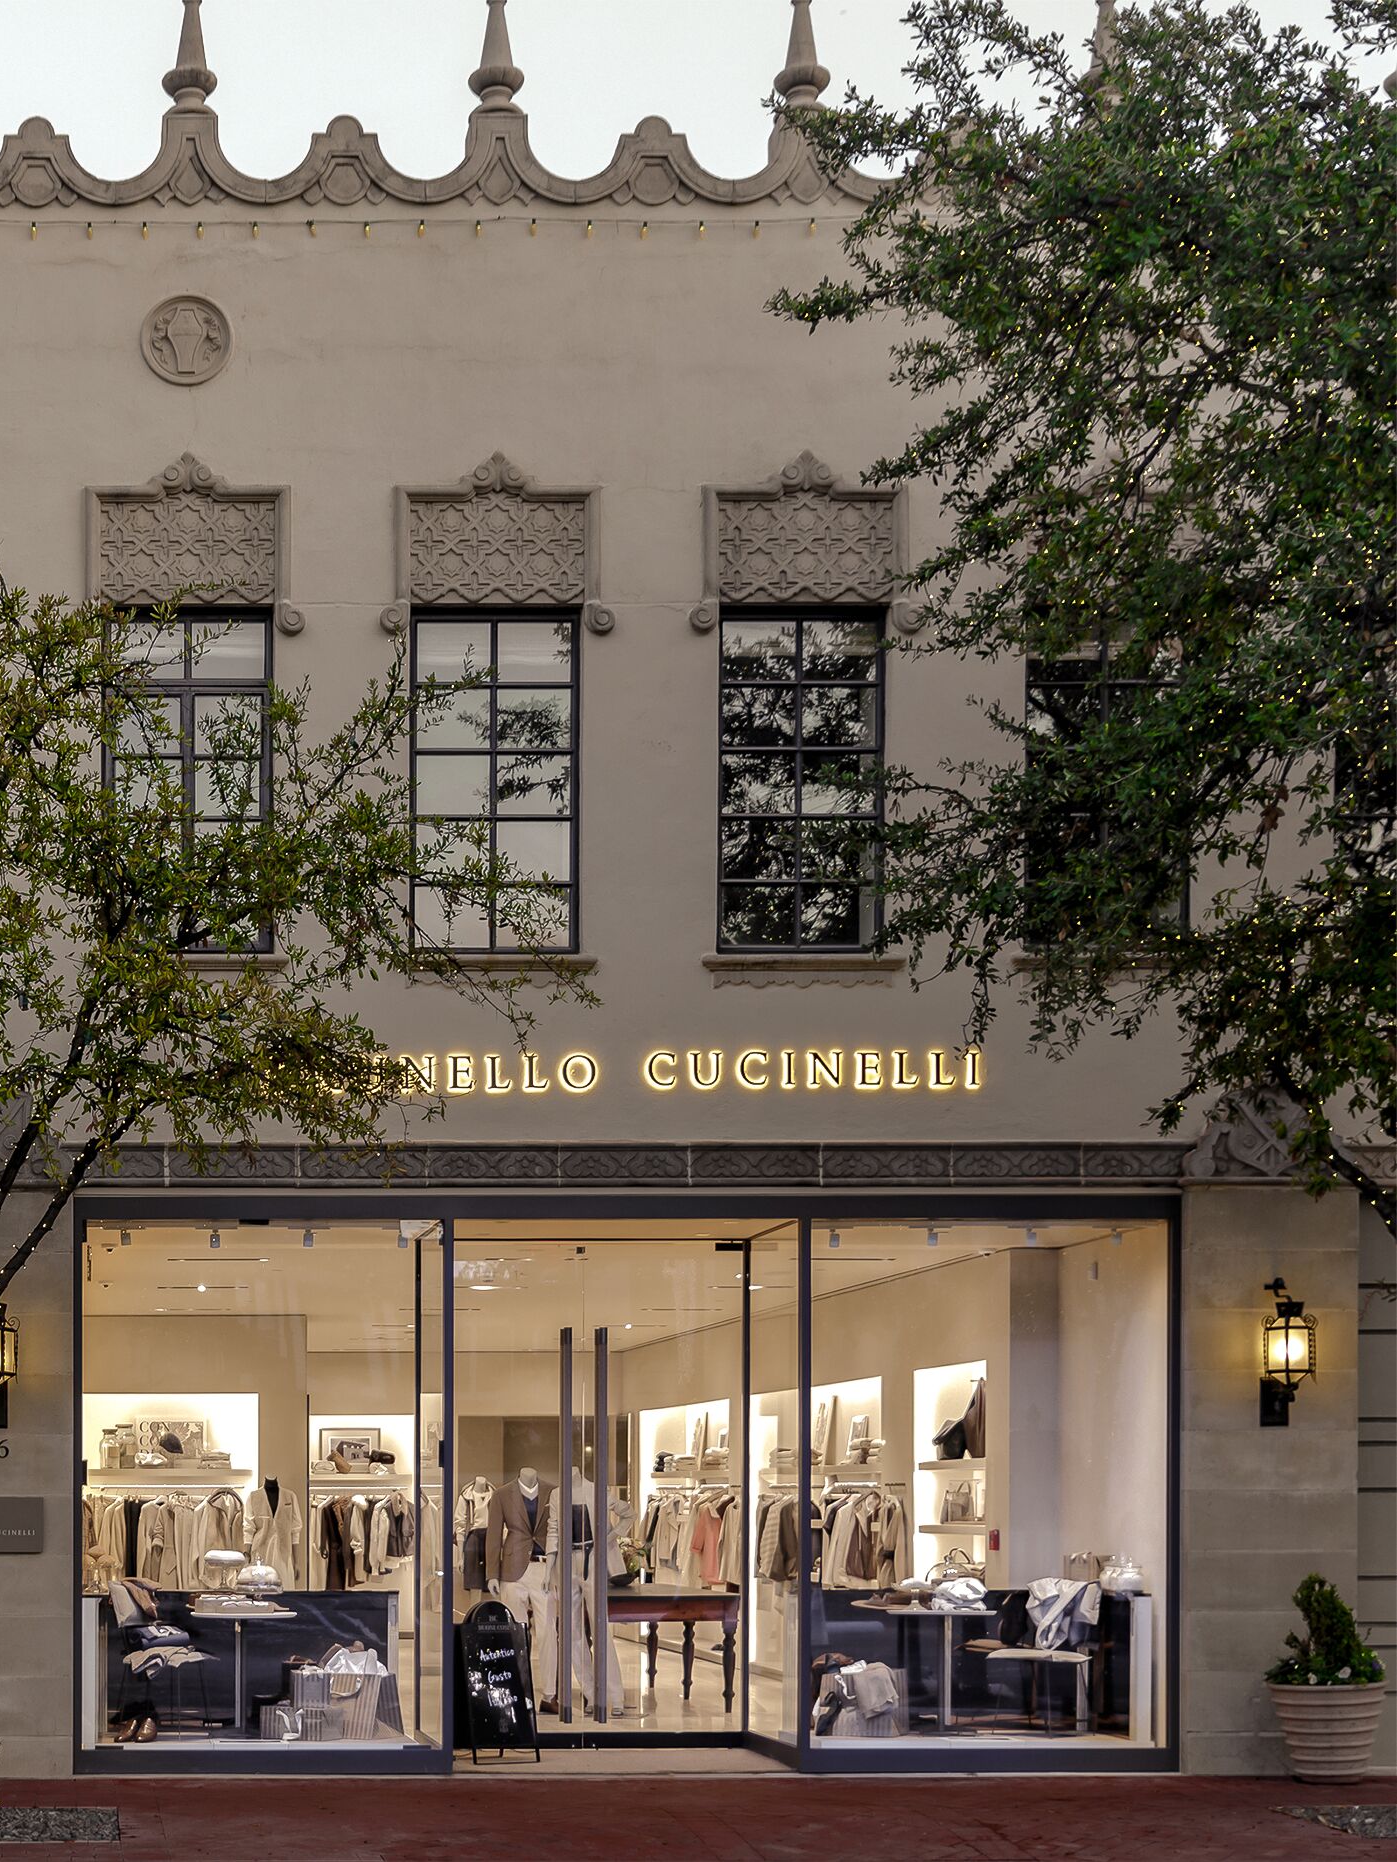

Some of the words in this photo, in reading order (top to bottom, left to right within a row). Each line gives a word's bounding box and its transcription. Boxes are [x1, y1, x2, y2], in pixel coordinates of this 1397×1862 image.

[268, 1054, 597, 1090] UNELLO
[646, 1049, 981, 1088] CUCINELLI
[487, 1670, 512, 1683] Gusto
